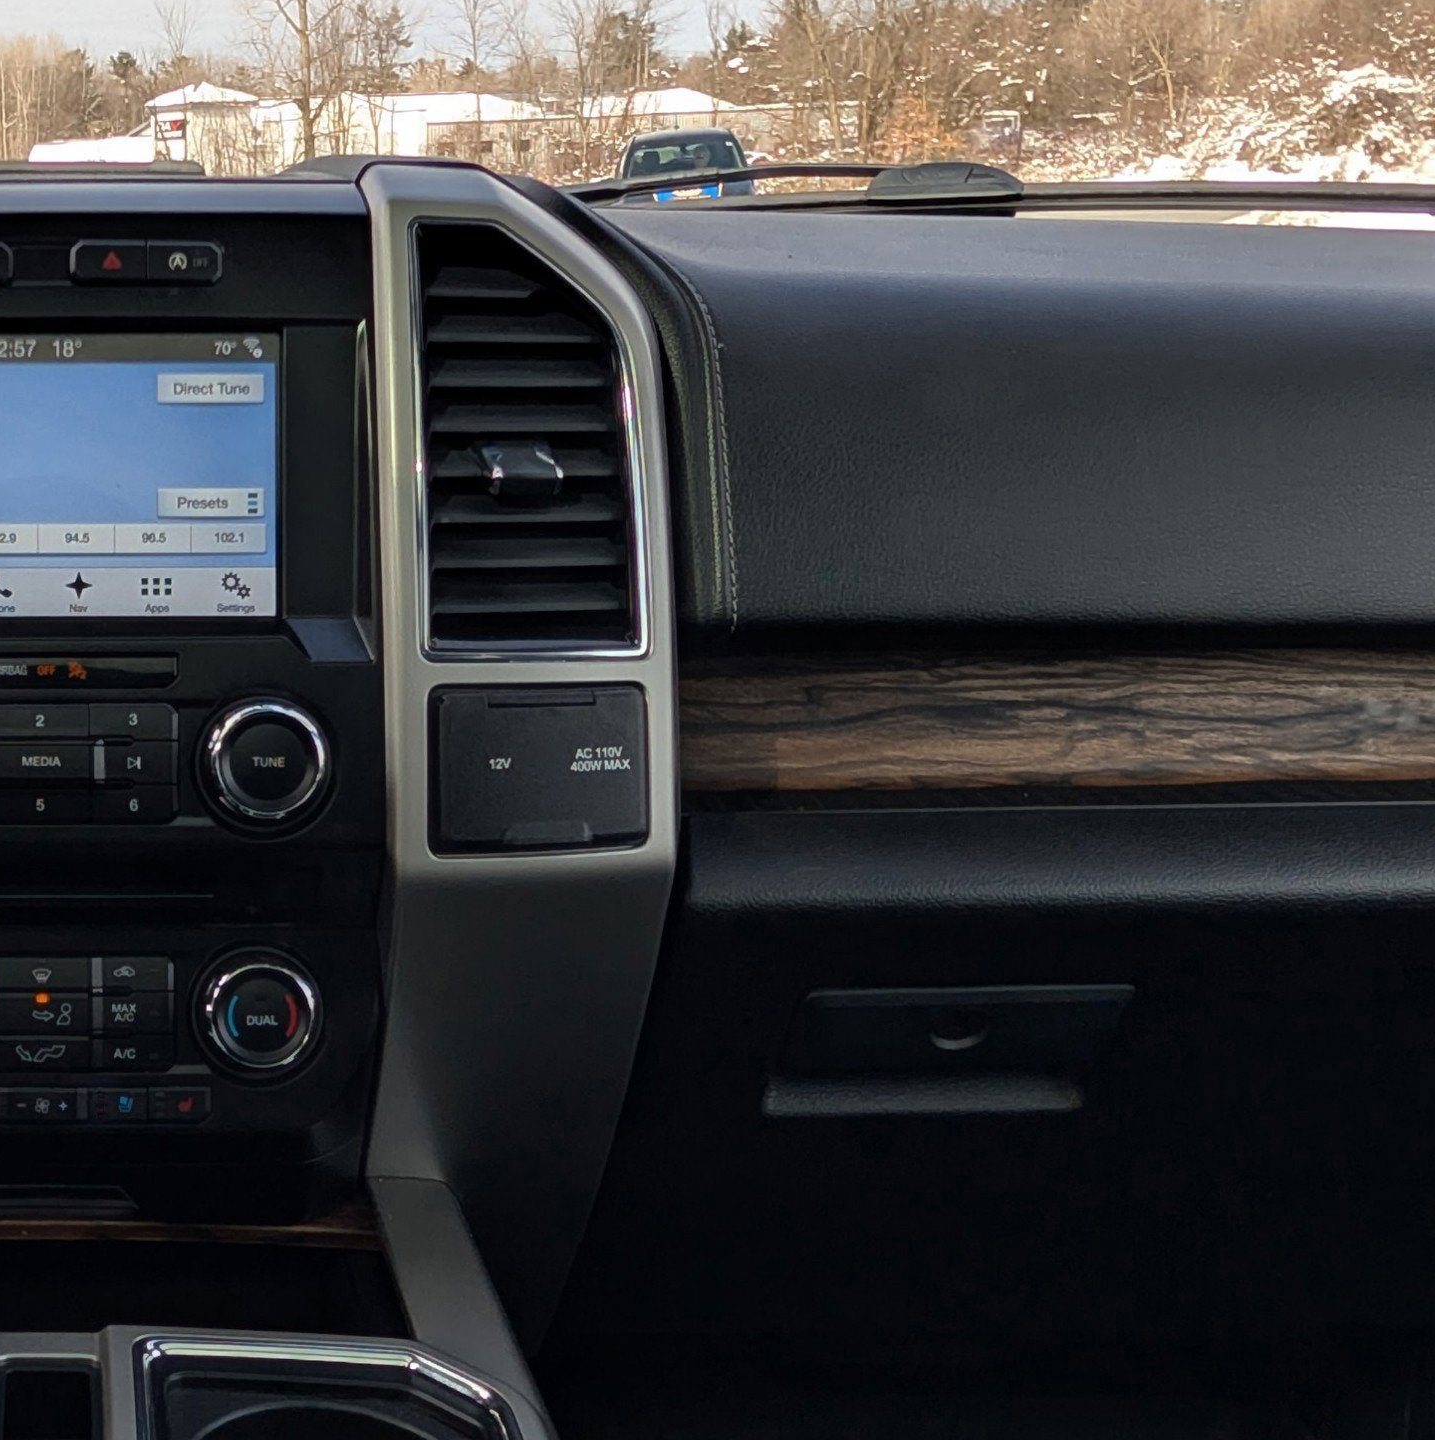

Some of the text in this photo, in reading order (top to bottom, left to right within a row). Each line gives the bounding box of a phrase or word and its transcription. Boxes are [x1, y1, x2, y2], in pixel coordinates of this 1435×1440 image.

[172, 381, 251, 397] Direct Tune
[176, 495, 229, 511] Presets
[68, 603, 88, 614] Nav
[144, 602, 170, 616] Apps
[215, 602, 256, 616] Settings
[37, 664, 56, 676] OFF
[35, 714, 45, 727] 2
[128, 713, 138, 727] 3
[575, 746, 623, 759] AC 110V
[21, 756, 62, 768] MEDIA
[252, 756, 286, 768] TUNE
[489, 758, 512, 770] 12V
[570, 758, 631, 772] 400W MAX
[35, 799, 45, 812] 5
[129, 799, 139, 812] 6
[111, 1003, 137, 1013] MAX
[245, 1014, 279, 1027] DUAL
[113, 1048, 137, 1059] A/C
